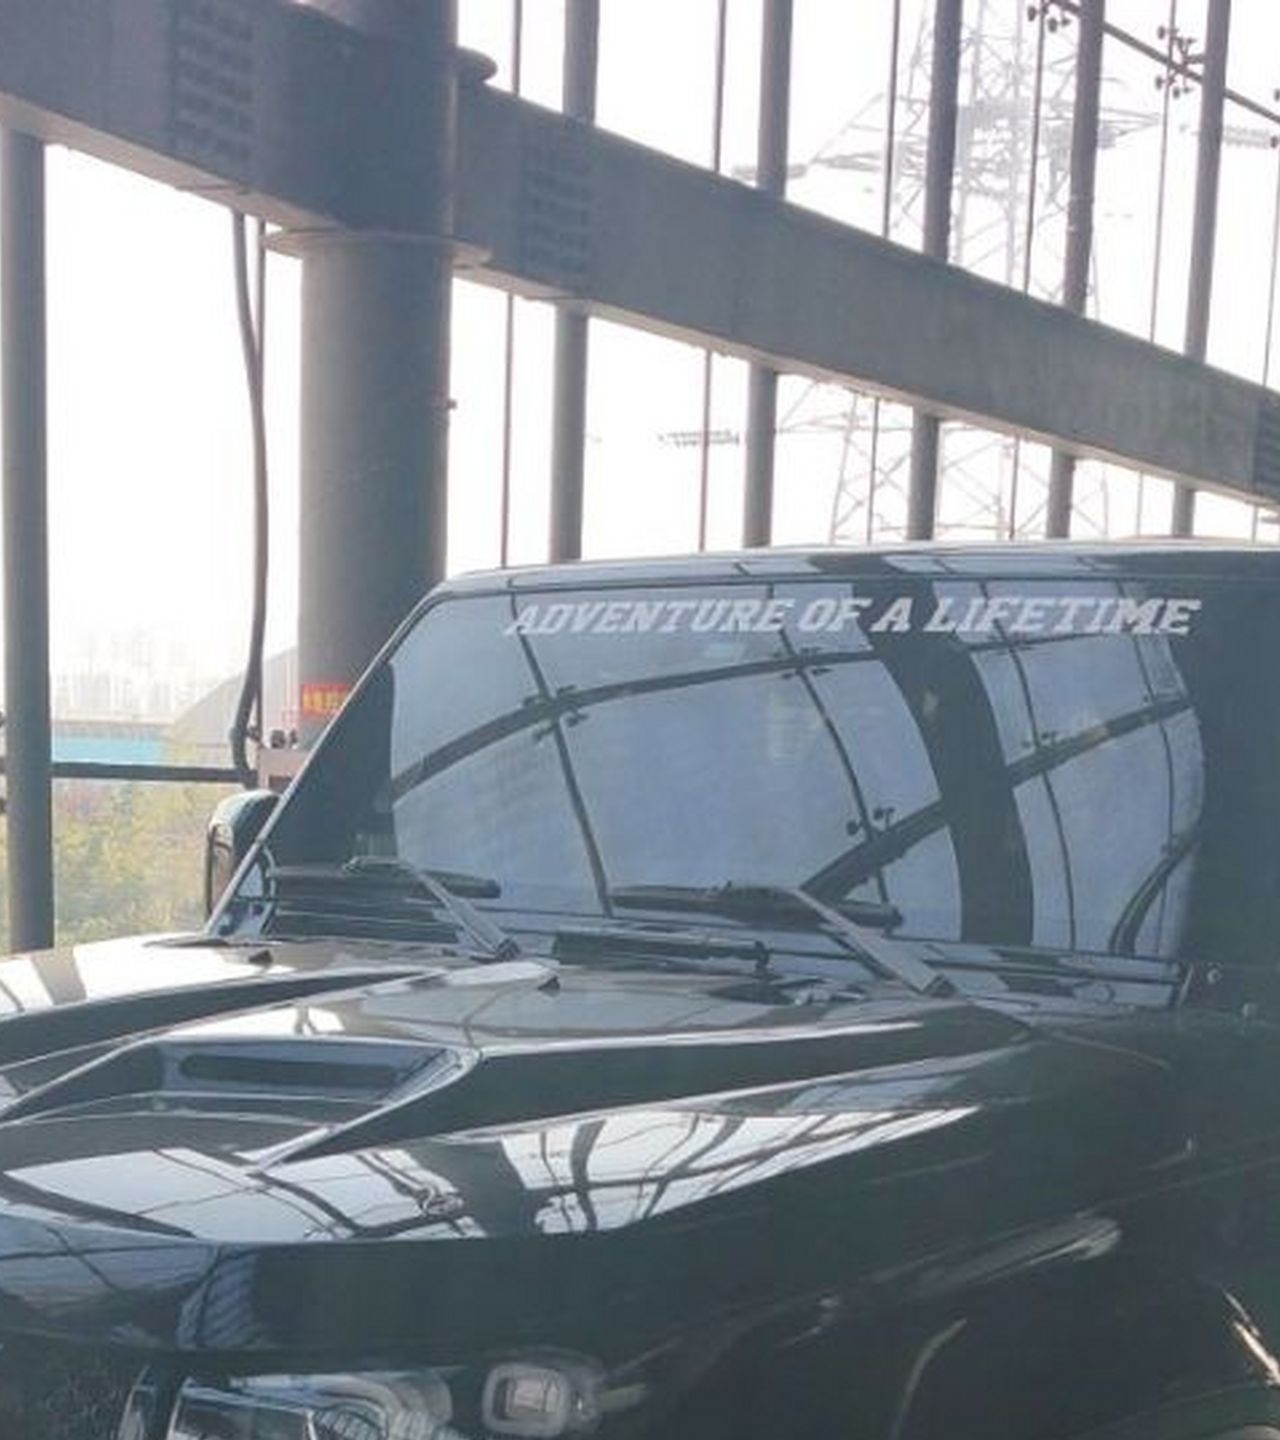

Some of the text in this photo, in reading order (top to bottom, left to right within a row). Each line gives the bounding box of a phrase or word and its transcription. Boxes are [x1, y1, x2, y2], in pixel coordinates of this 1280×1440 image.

[504, 597, 1202, 635] ADVENTURE OF A LIFETIME
